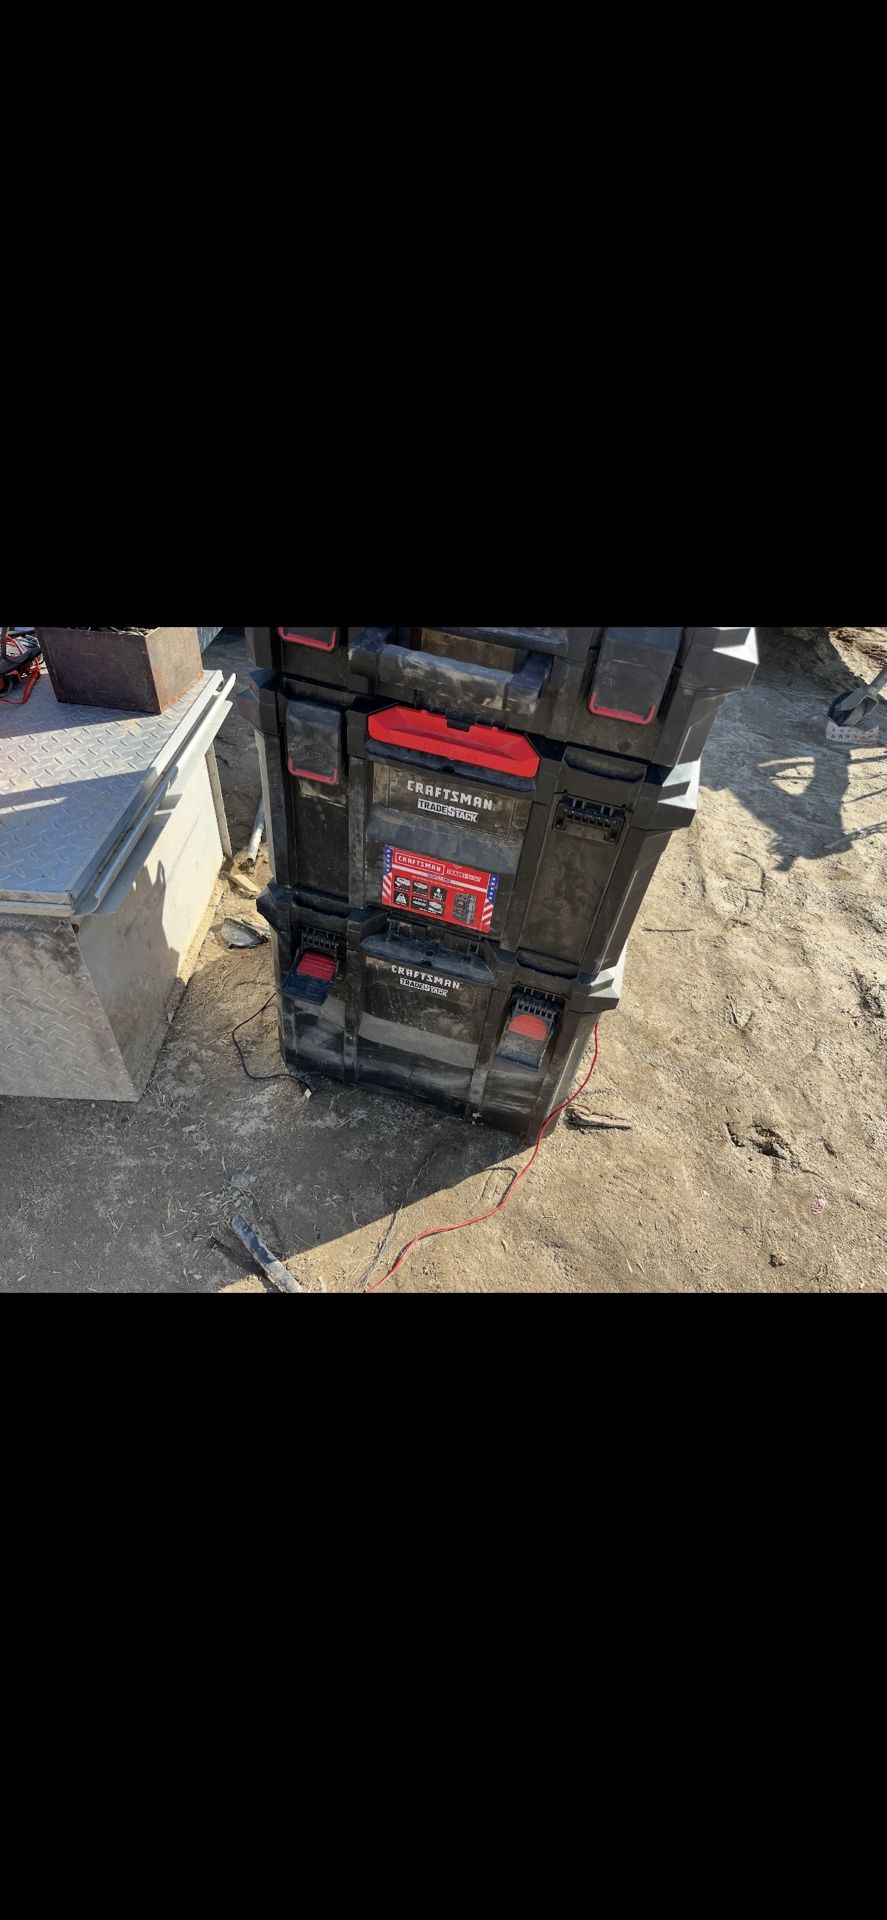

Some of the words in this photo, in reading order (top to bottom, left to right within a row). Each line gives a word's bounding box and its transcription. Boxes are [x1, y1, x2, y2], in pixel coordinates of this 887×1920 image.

[407, 780, 493, 811] CRAFTSMAN
[417, 798, 479, 822] TRADESTACK
[397, 855, 442, 873] CRAFTSMAN
[391, 964, 460, 990] CRAFTSMAN
